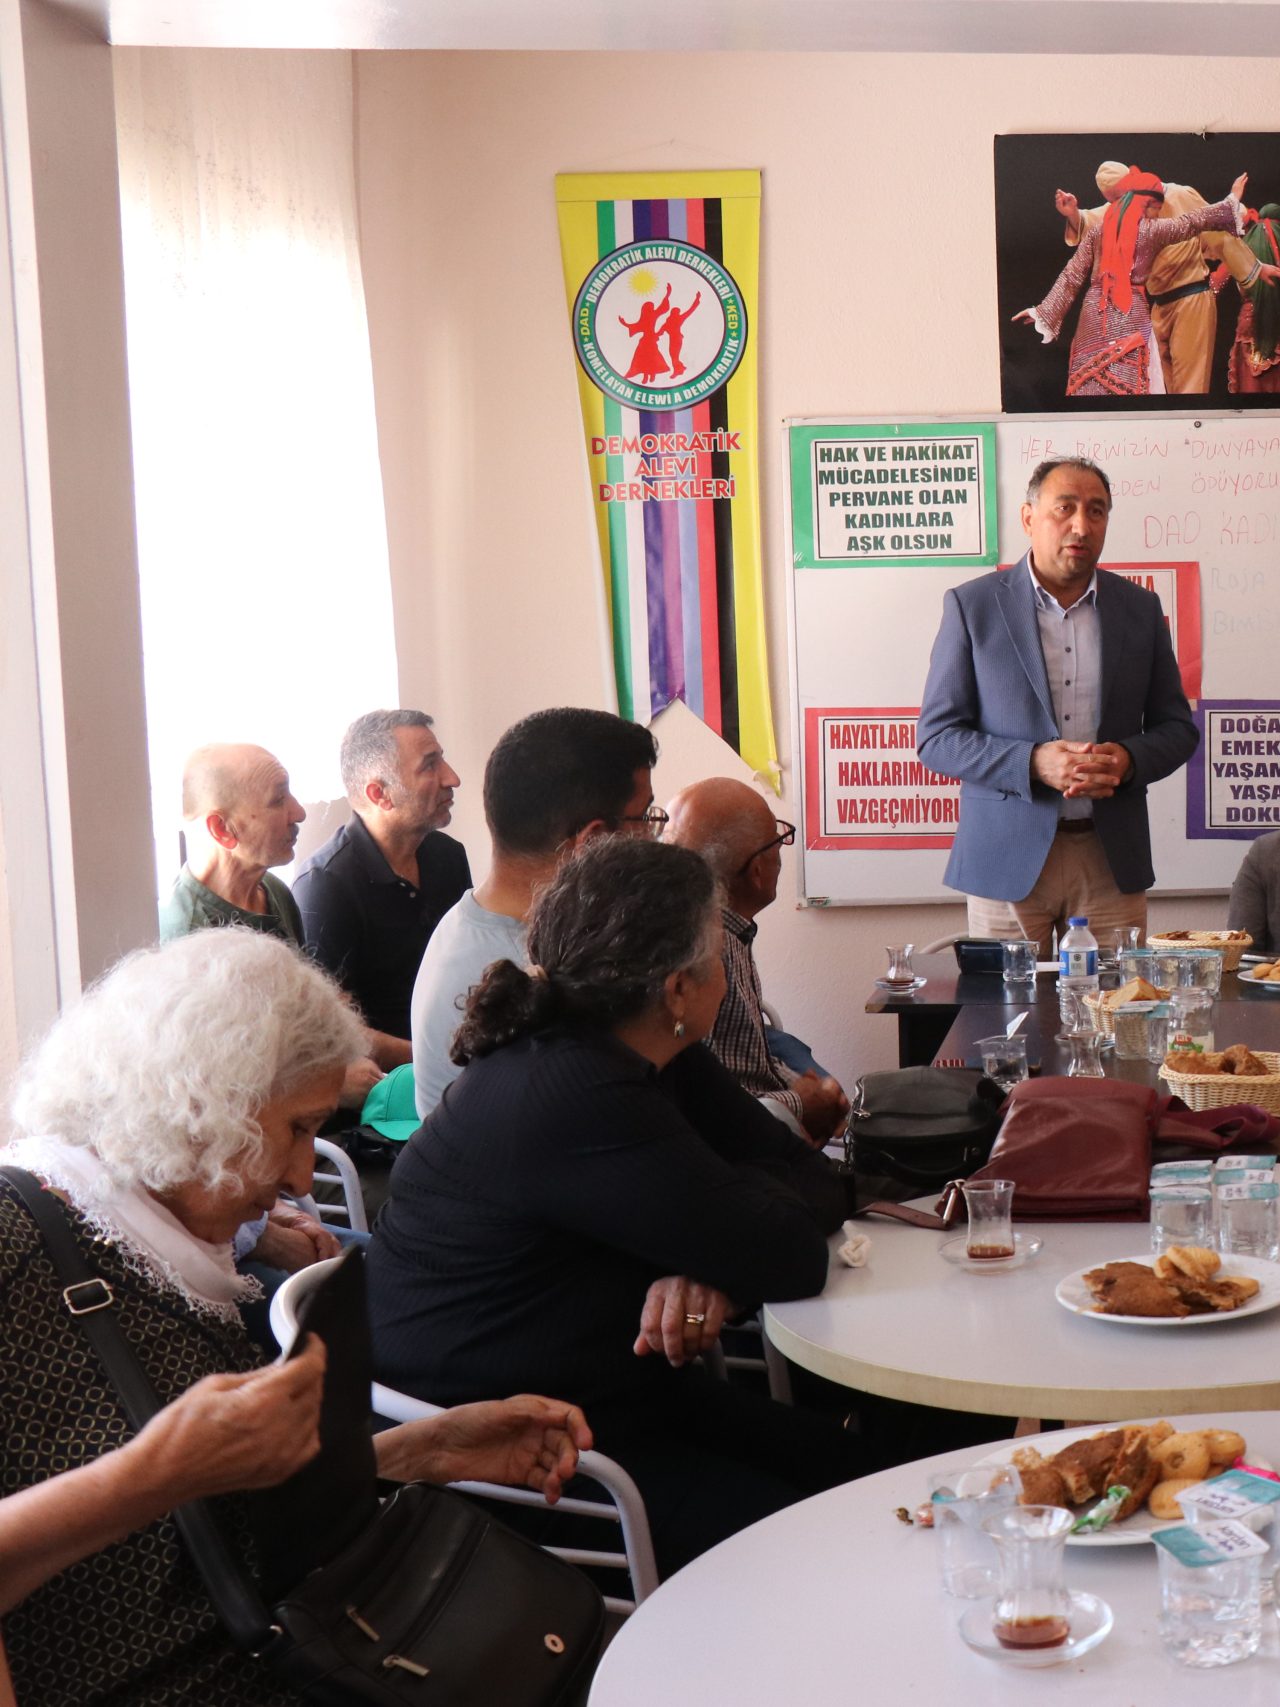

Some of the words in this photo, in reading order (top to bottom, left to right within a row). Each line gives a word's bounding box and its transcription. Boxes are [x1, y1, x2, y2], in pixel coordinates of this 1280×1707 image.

[586, 249, 643, 304] DEMOKRATİK
[644, 246, 676, 259] ALEVİ
[678, 250, 734, 299] DERNEKLERİ
[580, 308, 590, 336] DAD
[726, 304, 739, 330] KED
[583, 342, 632, 398] KOMELAYAN
[674, 394, 683, 404] A
[684, 338, 739, 400] DEMOKRATİK
[591, 428, 741, 455] DEMOKRATİK
[820, 447, 858, 462] HAK
[863, 447, 886, 461] VE
[892, 443, 974, 460] HAKİKAT
[1020, 435, 1057, 464] HER
[635, 453, 697, 477] ALEVİ
[818, 465, 977, 485] MÜCADELESİNDE
[599, 476, 736, 502] DERNEKLERİ
[829, 490, 914, 507] PERVANE
[919, 489, 967, 504] OLAN
[844, 511, 954, 529] KADINLARA
[847, 535, 885, 555] AŞK
[891, 534, 952, 550] OLSUN
[830, 724, 915, 749] HAYATLARI
[1221, 740, 1280, 756] EMEK
[838, 761, 961, 786] HAKLARIMIZD
[837, 794, 960, 828] VAZGEÇMİYORU
